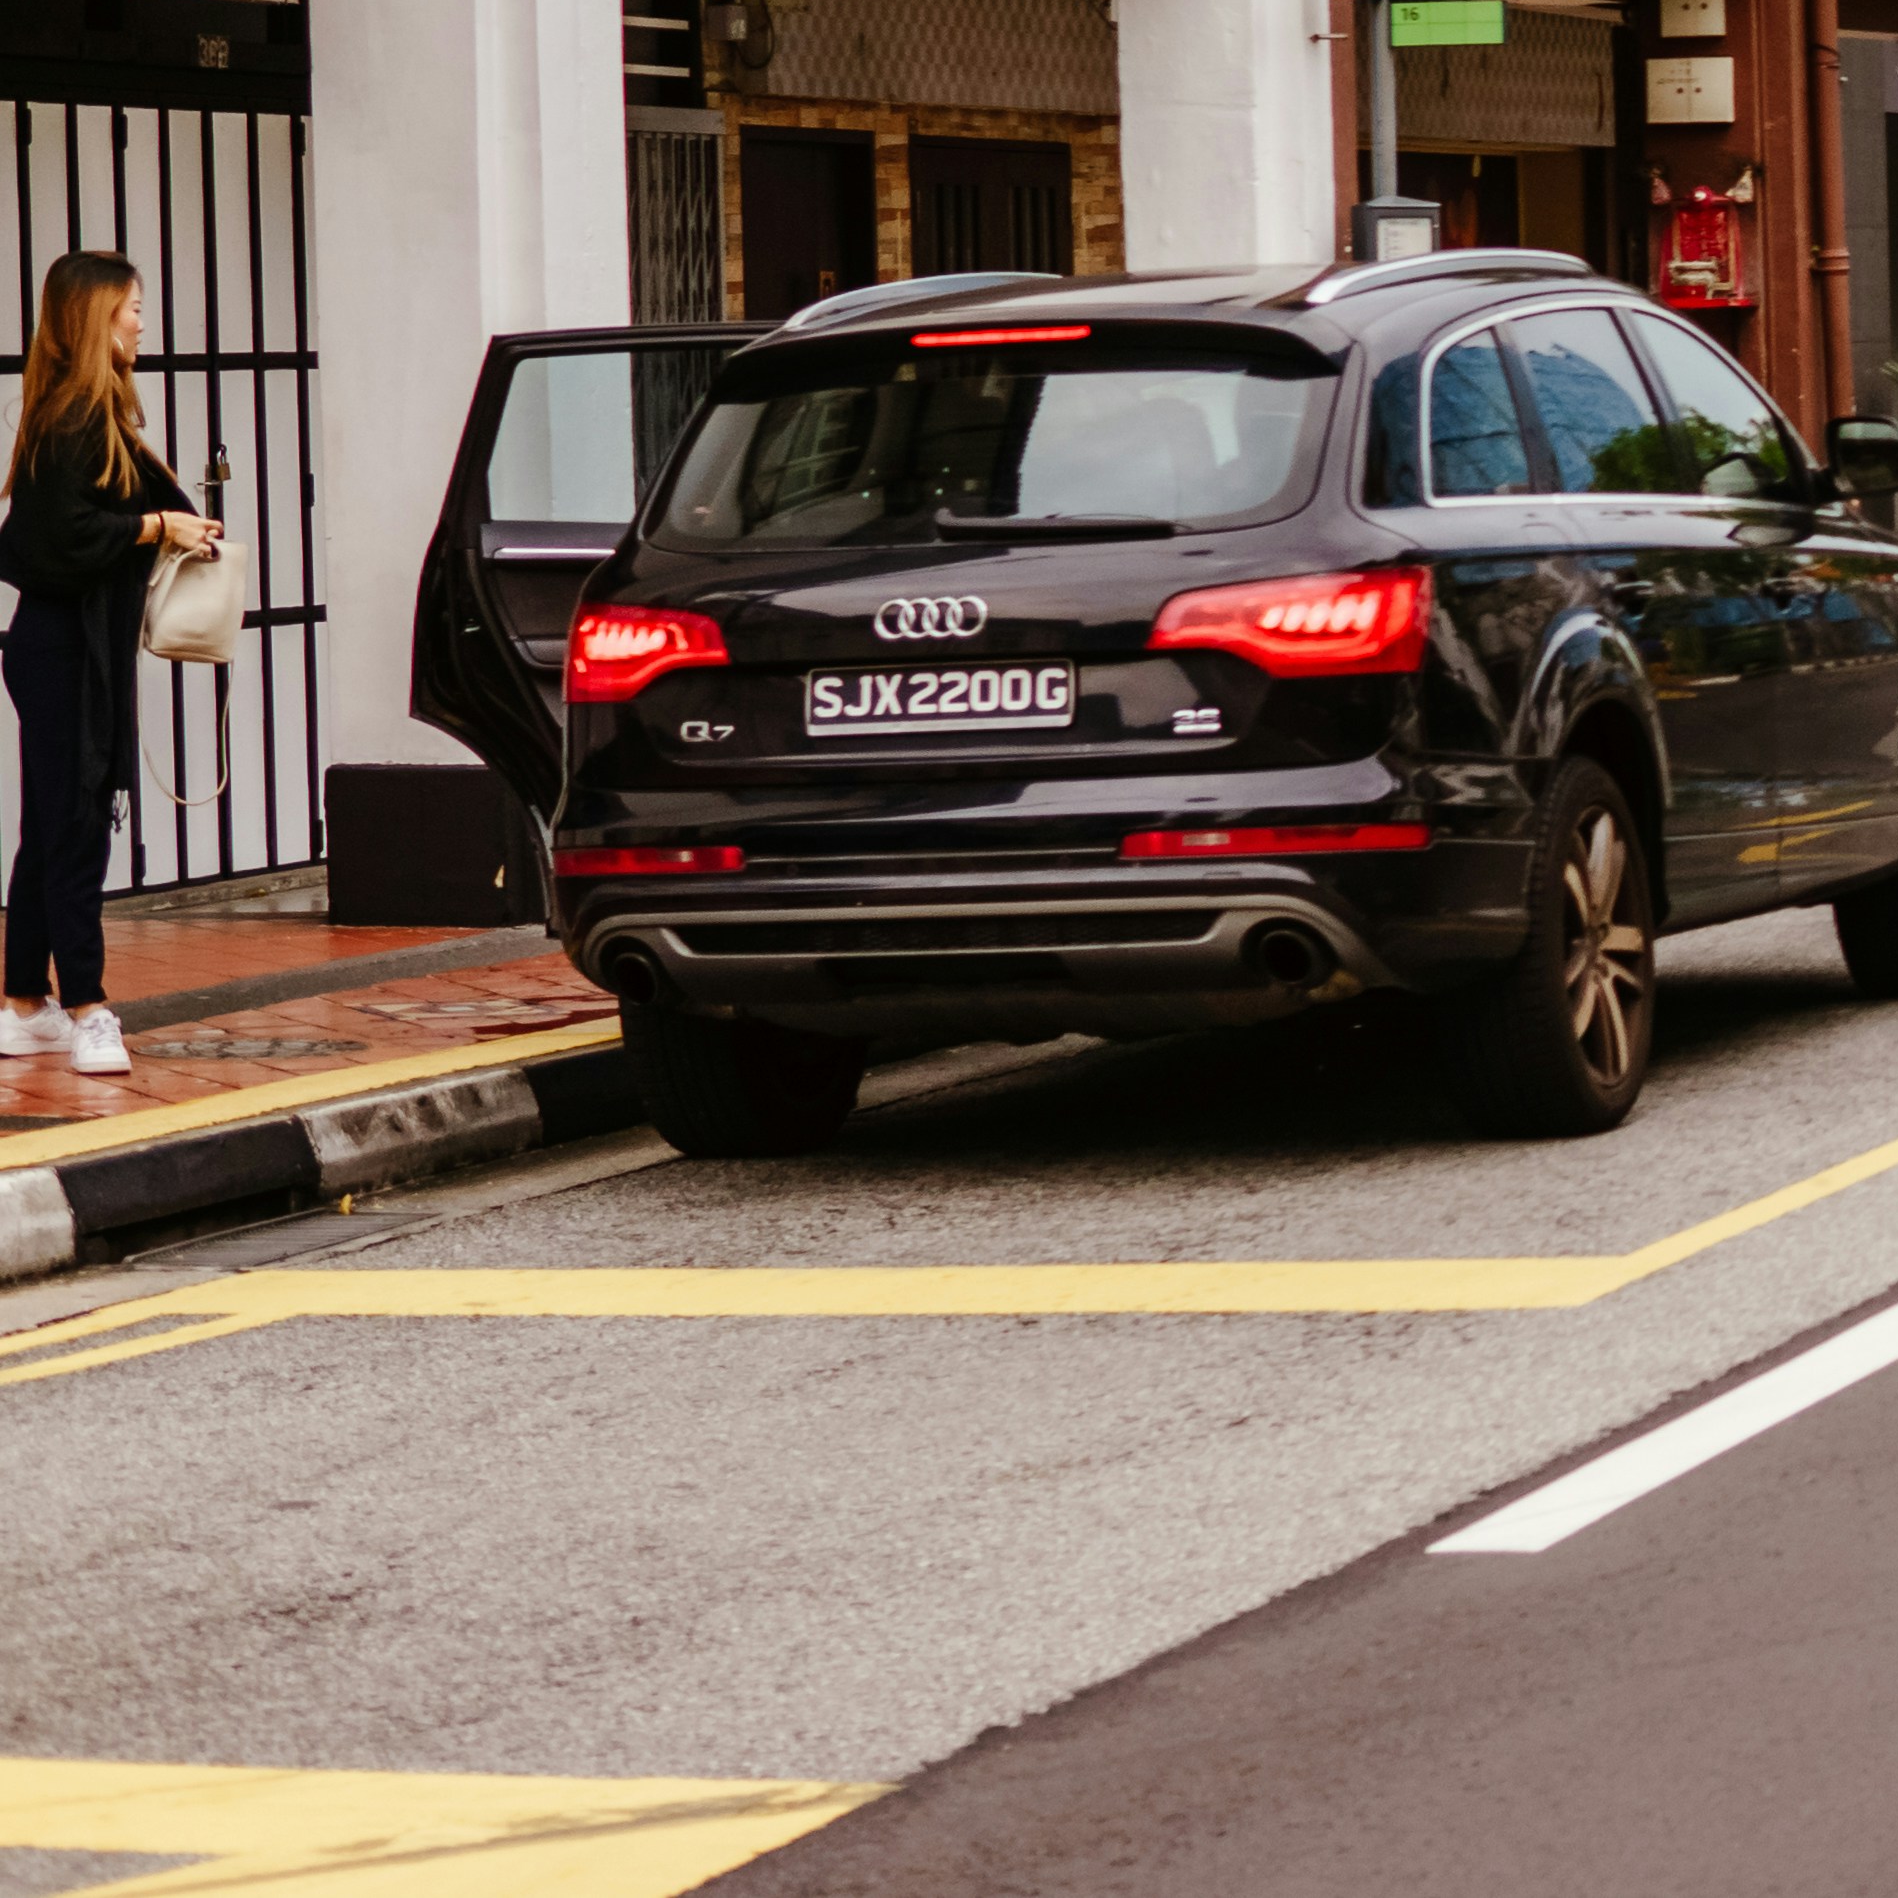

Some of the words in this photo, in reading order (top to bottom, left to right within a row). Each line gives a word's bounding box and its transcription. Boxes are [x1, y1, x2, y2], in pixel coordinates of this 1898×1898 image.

[1400, 7, 1420, 21] 16
[813, 667, 1068, 719] SJX2200G
[680, 720, 735, 743] Q7
